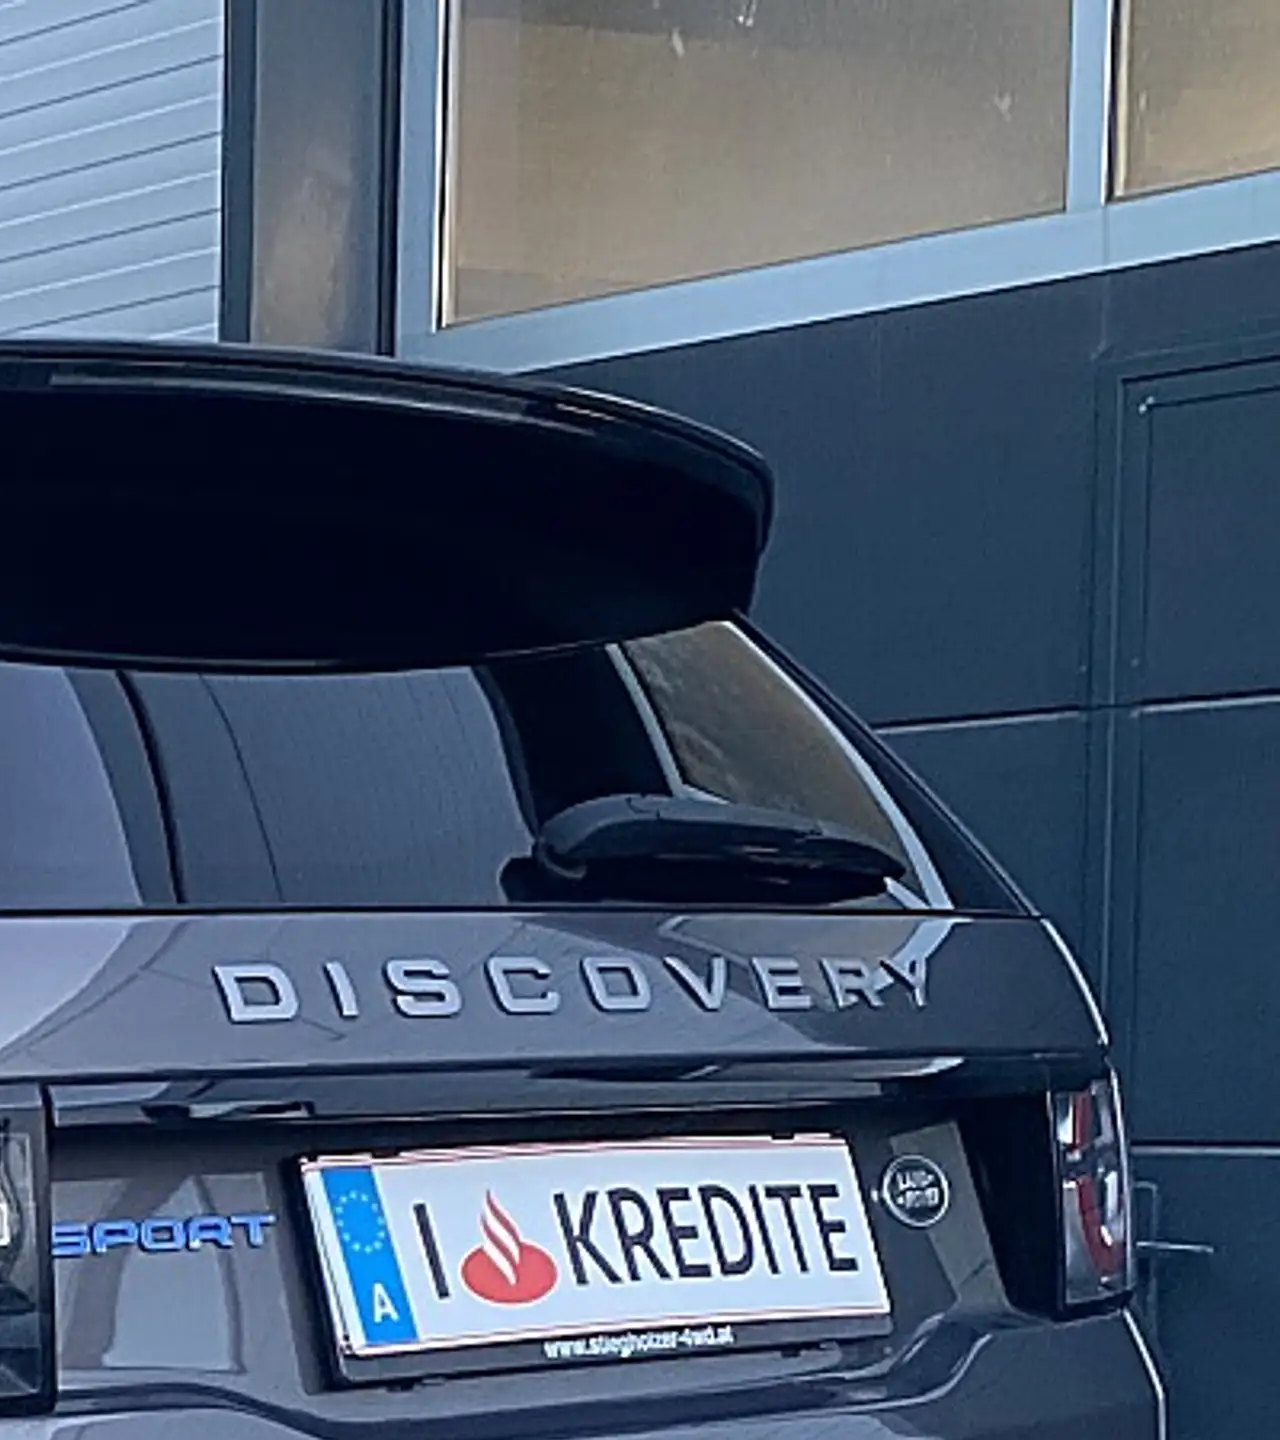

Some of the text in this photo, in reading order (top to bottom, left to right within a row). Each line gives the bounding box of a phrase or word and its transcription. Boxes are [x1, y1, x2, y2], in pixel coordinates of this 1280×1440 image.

[213, 955, 930, 1022] DISCOVERY
[51, 1213, 277, 1257] SPORT
[413, 1183, 860, 1298] I KREDITE
[372, 1282, 400, 1323] A
